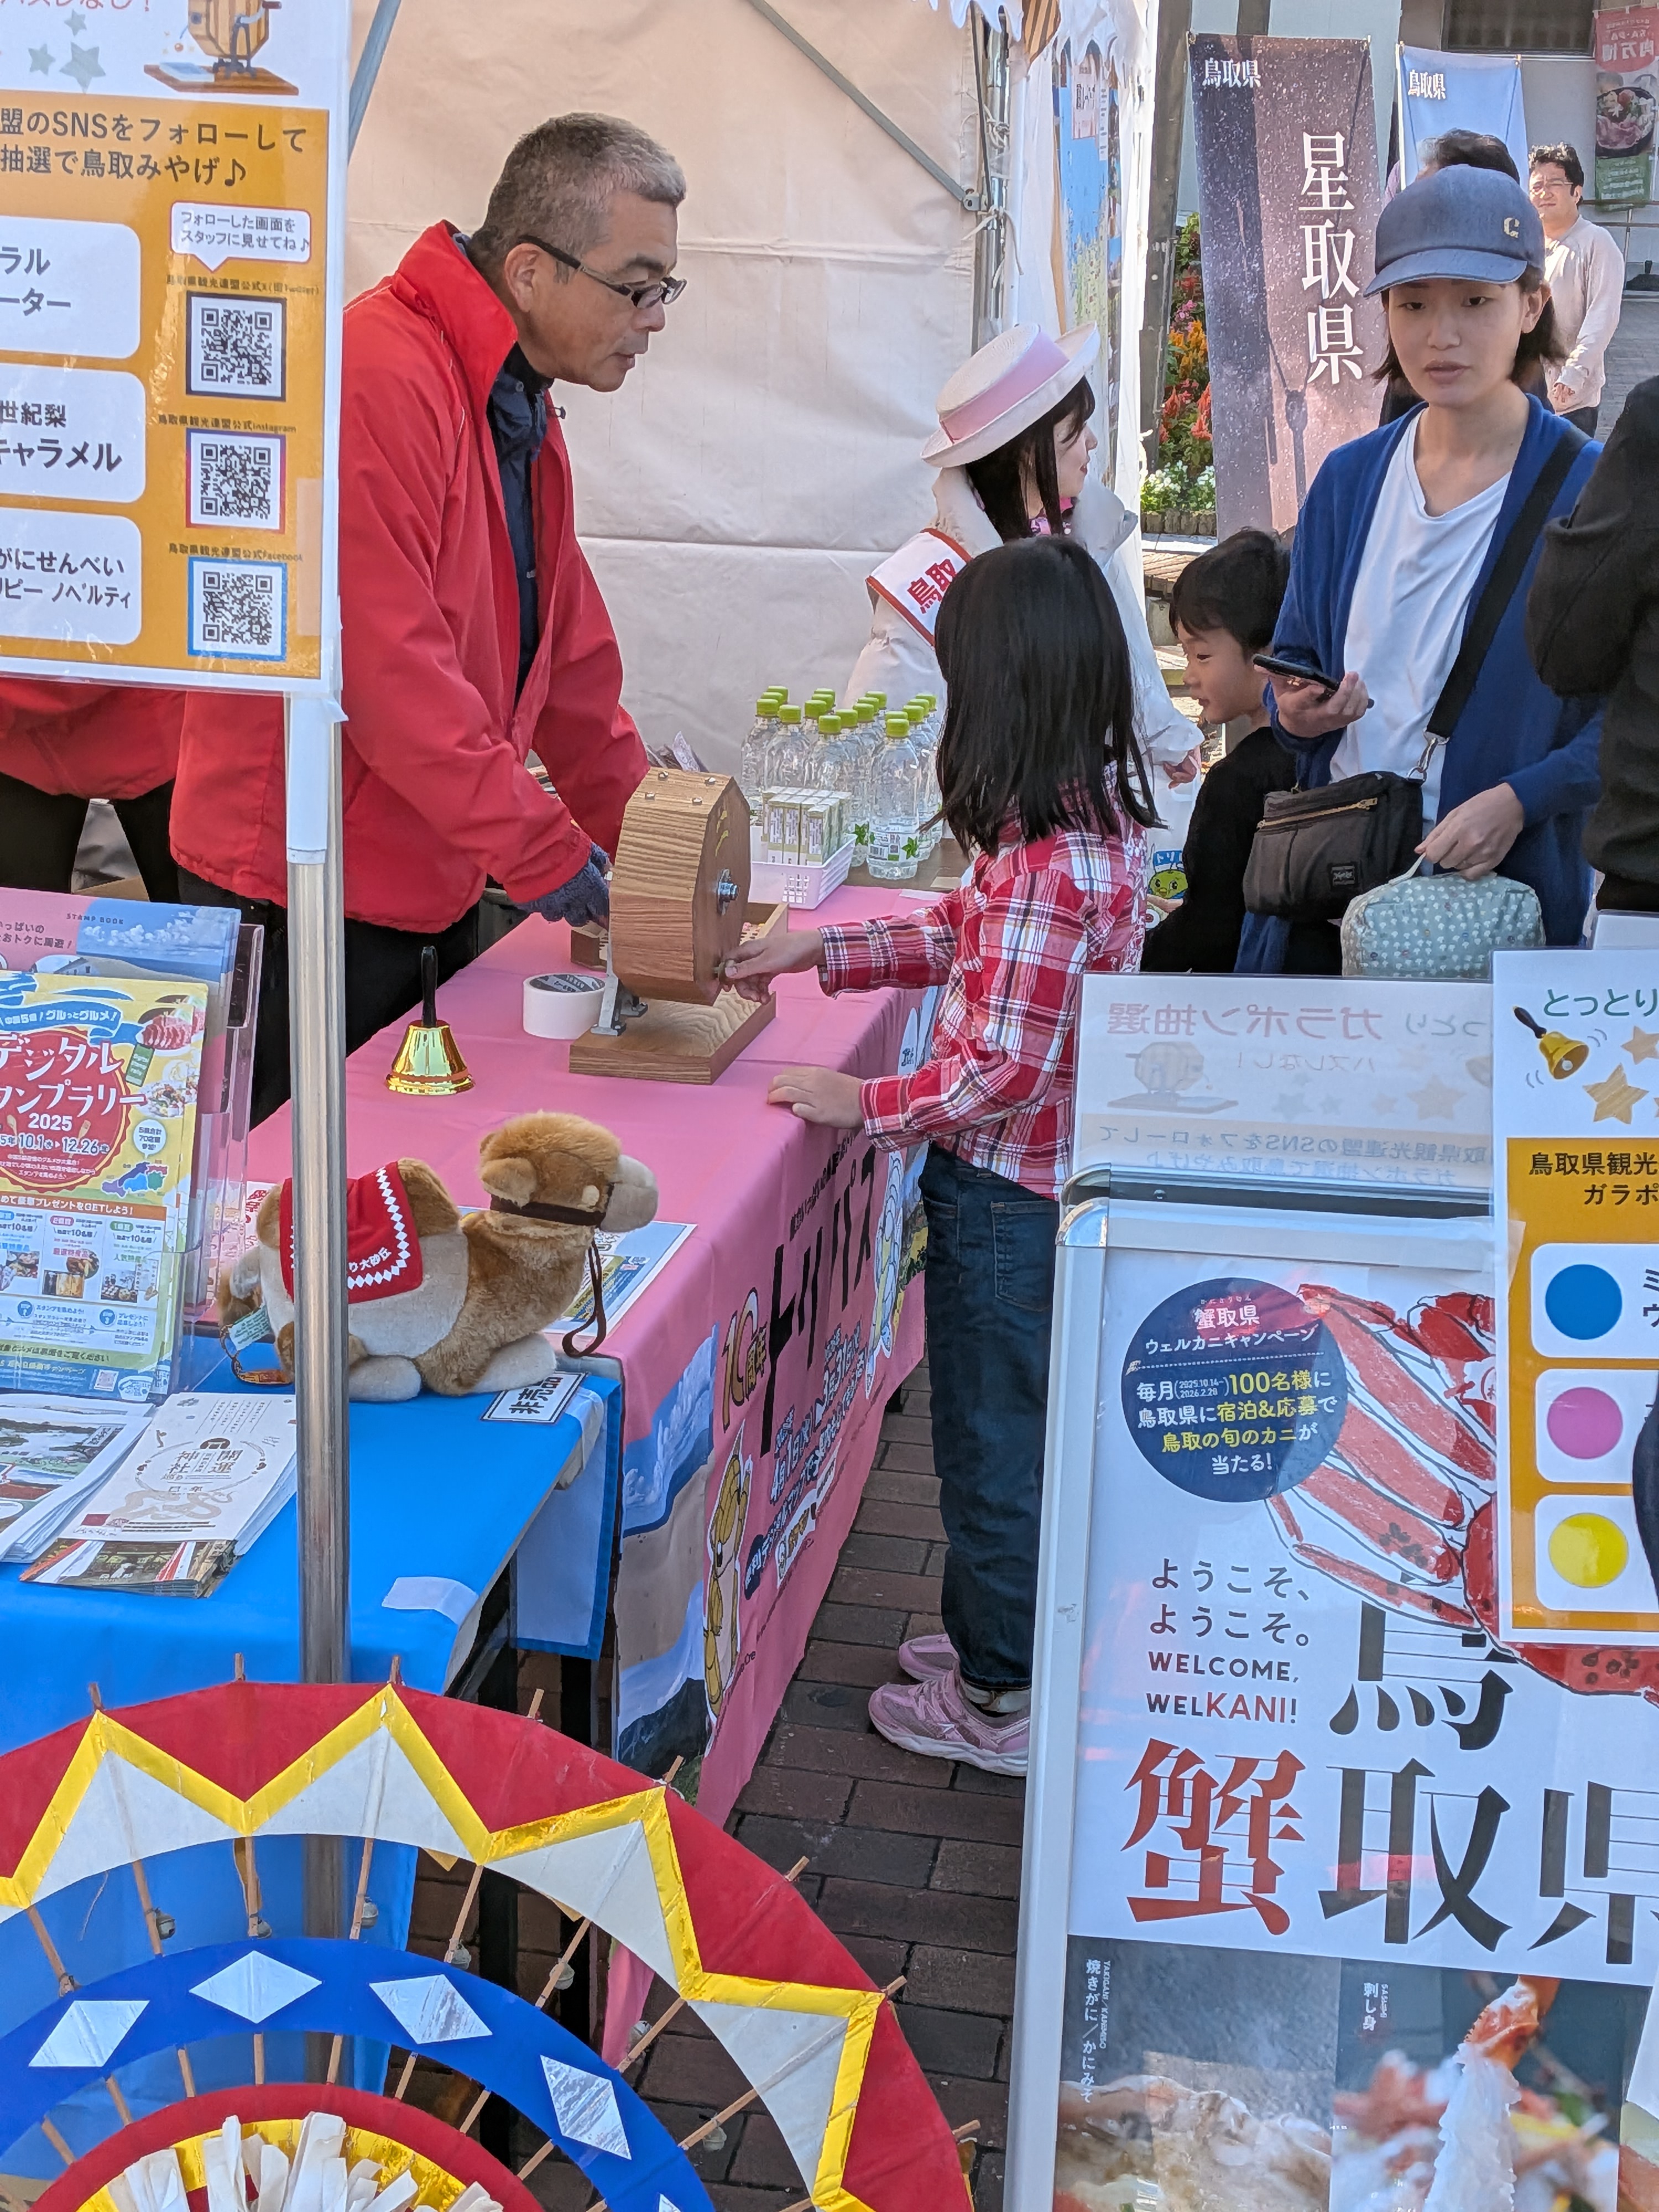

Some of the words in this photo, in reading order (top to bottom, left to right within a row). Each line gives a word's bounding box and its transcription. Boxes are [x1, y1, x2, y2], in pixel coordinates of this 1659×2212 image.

[1202, 58, 1261, 88] 鳥取県
[1407, 69, 1446, 100] 鳥取県
[1, 107, 307, 153] 盟のSNSをフォローして
[181, 212, 295, 233] フォローした画面を
[1298, 131, 1363, 385] 星取県
[1, 400, 67, 428] 世紀梨
[907, 557, 957, 614] 鳥取
[66, 913, 96, 921] STAMP
[28, 1113, 72, 1131] 2025
[760, 1143, 877, 1458] トリパス
[1193, 1305, 1260, 1329] 蟹取県
[1145, 1323, 1319, 1355] ウェルカニキャンペーン
[721, 1287, 768, 1433] 10周年
[1136, 1381, 1174, 1403] 毎月
[1229, 1370, 1331, 1396] 100名様に
[1138, 1395, 1338, 1428] 鳥取県に宿泊&応募で
[1162, 1422, 1318, 1453] 鳥取の旬のカニが
[1212, 1454, 1272, 1475] 当たる!
[1152, 1558, 1309, 1601] ようこそ、
[1150, 1603, 1309, 1647] ようこそ。
[1148, 1651, 1299, 1683] WELCOME,
[1146, 1691, 1297, 1724] WELKANI!
